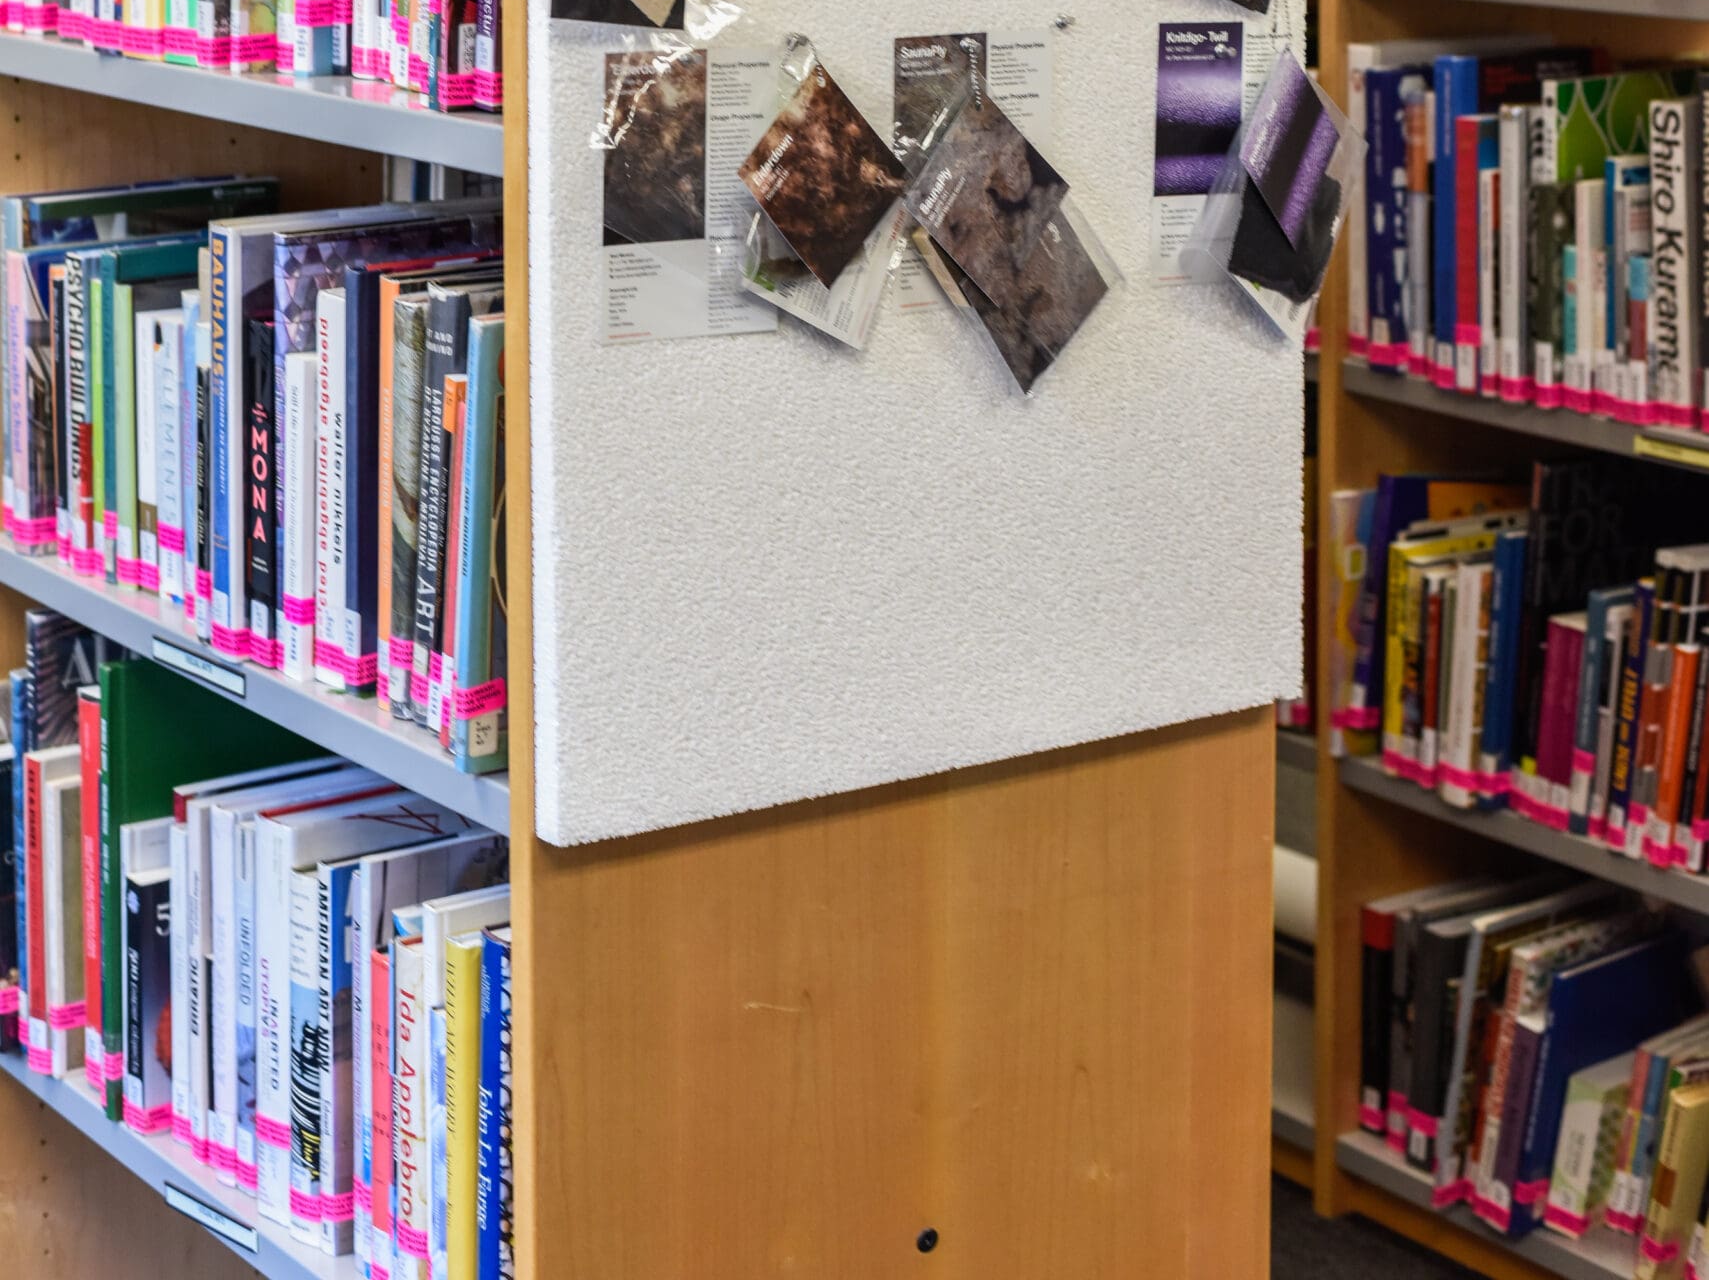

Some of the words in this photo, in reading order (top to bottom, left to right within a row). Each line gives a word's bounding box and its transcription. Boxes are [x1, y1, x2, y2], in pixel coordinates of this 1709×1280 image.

[1653, 106, 1682, 214] Shiro
[66, 256, 84, 355] PSYCHO
[211, 238, 224, 376] BAUHAUS
[9, 304, 22, 395] Sustainable
[318, 317, 329, 427] afgebeeld
[12, 398, 24, 454] School
[332, 412, 344, 482] walter
[420, 407, 432, 482] BYZANTINE
[428, 388, 442, 463] LAROUSSE
[251, 428, 270, 544] MONA
[318, 436, 330, 551] abgebildet
[426, 467, 440, 572] ENCYCLOPEDIA
[333, 488, 345, 566] nikkels
[417, 503, 430, 567] MEDIEVAL
[414, 575, 436, 638] ART
[239, 917, 251, 1006] UNFOLDED
[317, 880, 329, 978] AMERICAN
[190, 958, 200, 1036] ERRATIC
[317, 985, 329, 1021] ART
[399, 989, 416, 1043] Ida
[445, 961, 456, 1023] WHAT
[318, 1026, 330, 1074] NOW
[478, 1084, 494, 1132] John
[478, 1140, 493, 1169] La
[476, 1173, 492, 1232] Farge
